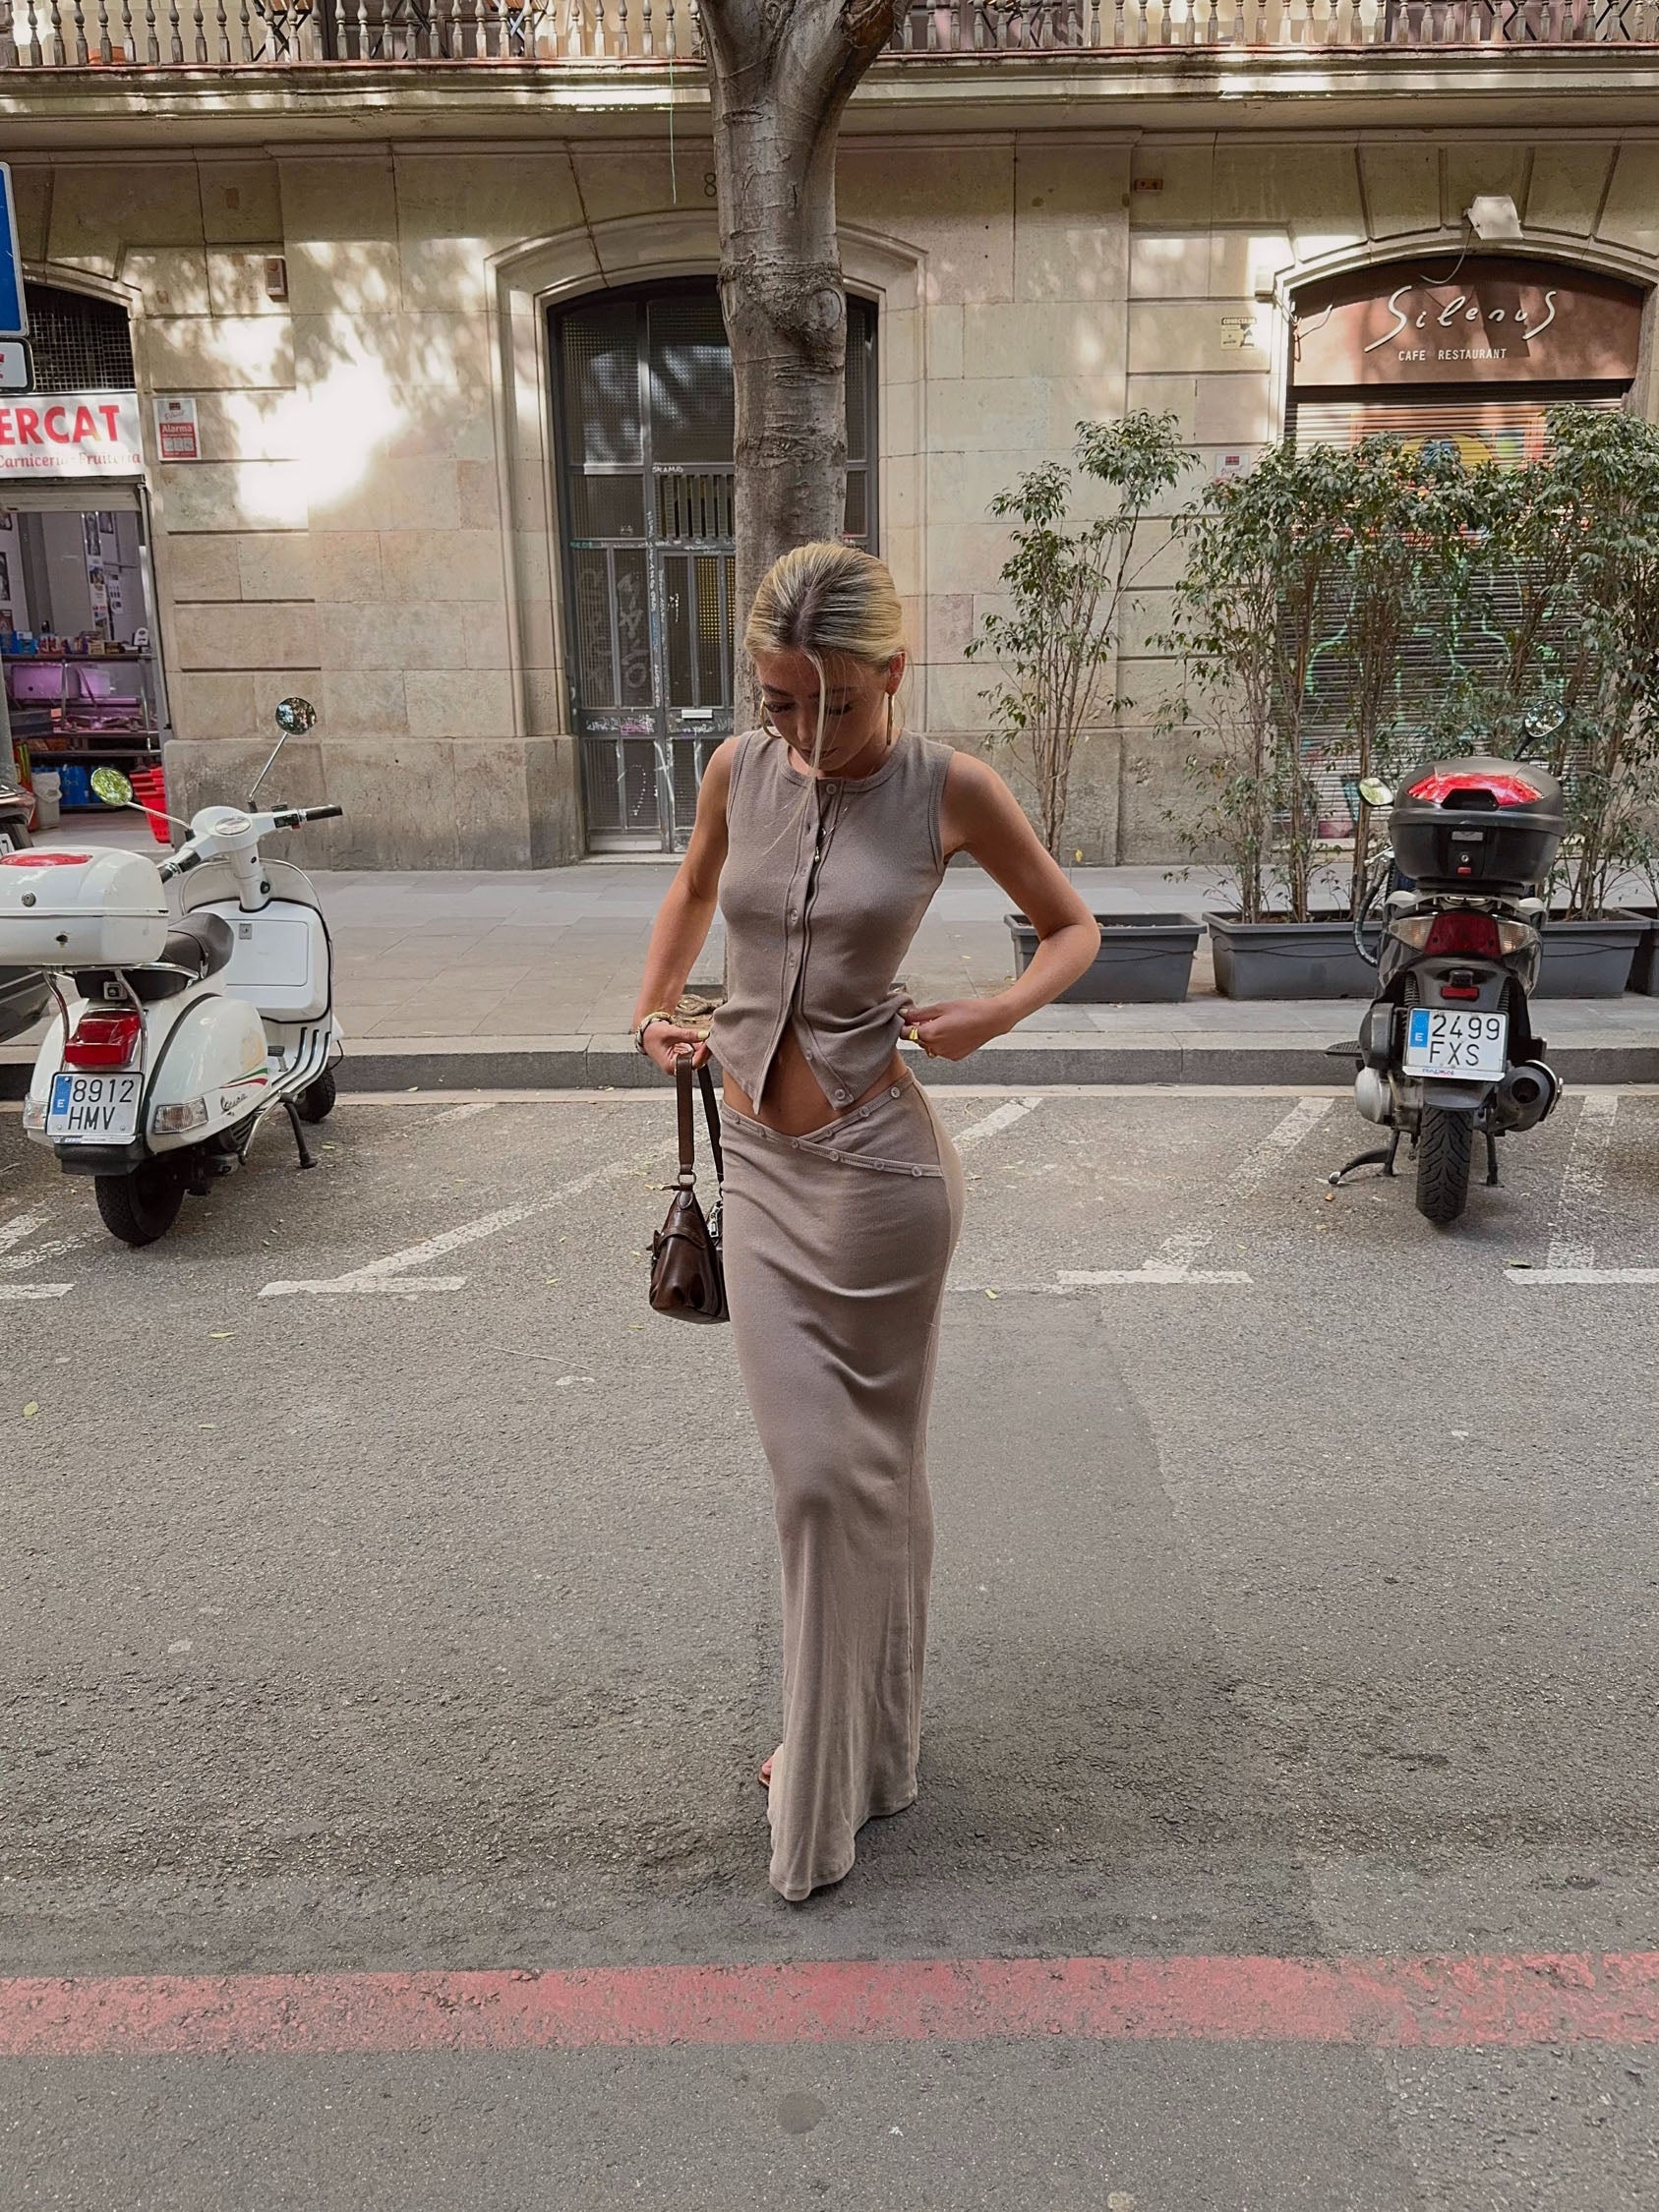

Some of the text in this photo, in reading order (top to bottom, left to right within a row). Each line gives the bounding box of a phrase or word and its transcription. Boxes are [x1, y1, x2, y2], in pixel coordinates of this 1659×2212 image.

[704, 172, 717, 197] 8
[1398, 348, 1507, 362] CAFE RESTAURANT
[162, 424, 194, 434] Alarma
[1415, 1014, 1501, 1042] E 2499
[1429, 1041, 1480, 1067] FXS
[57, 1078, 135, 1108] E 8912
[68, 1106, 116, 1131] HMV
